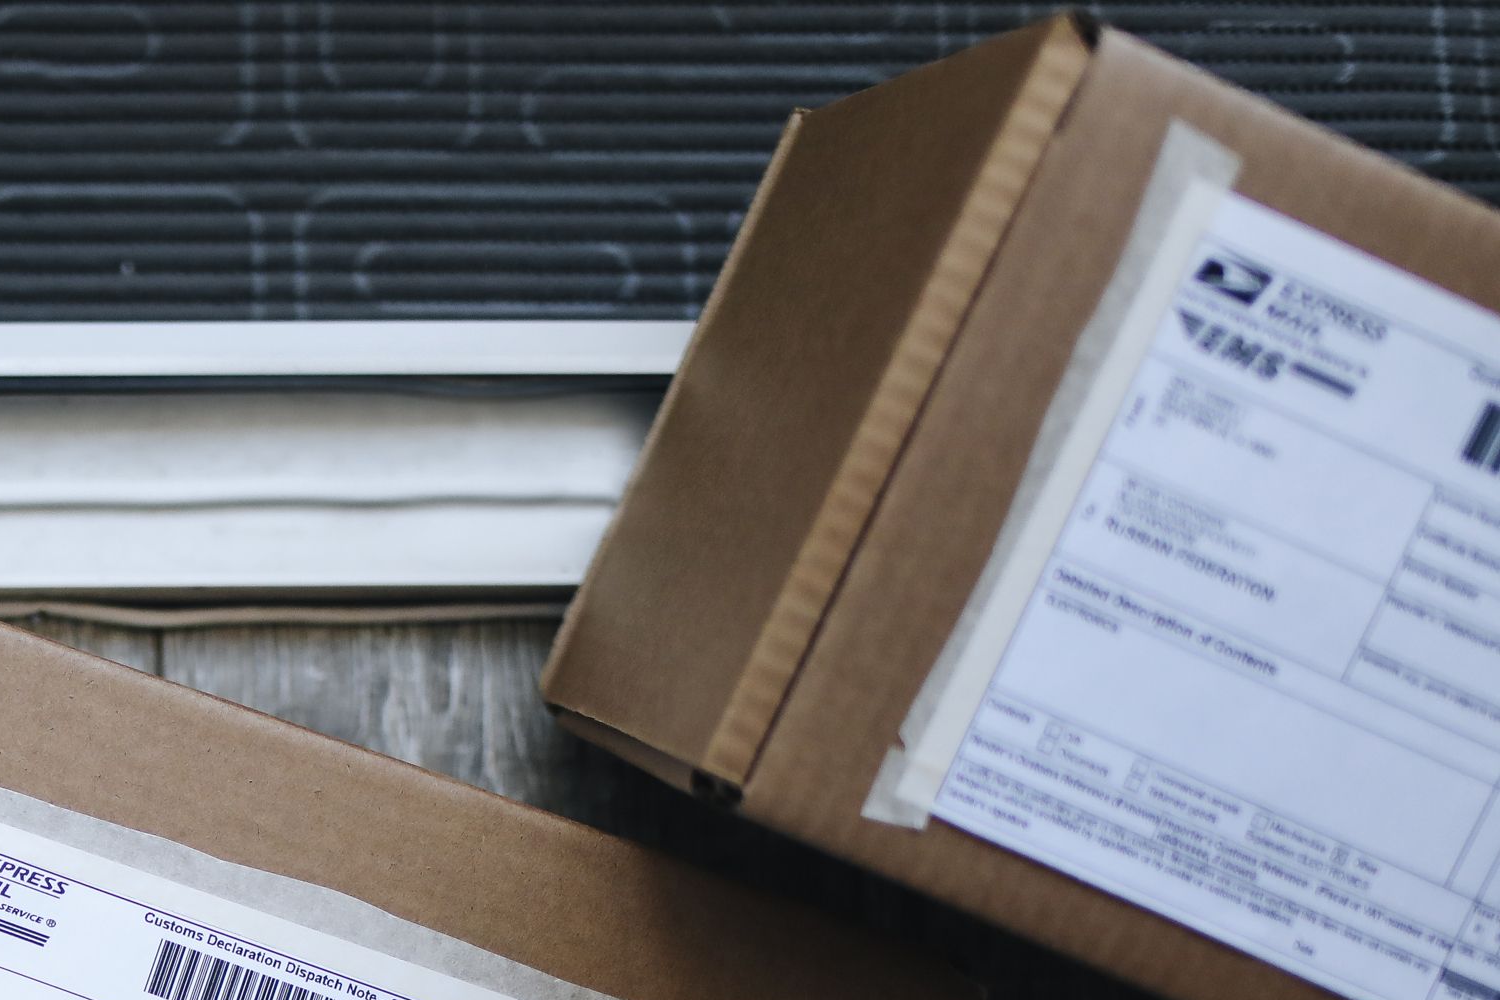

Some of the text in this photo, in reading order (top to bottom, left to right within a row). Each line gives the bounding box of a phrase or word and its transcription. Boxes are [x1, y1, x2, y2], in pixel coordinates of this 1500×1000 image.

[144, 911, 204, 941] Customs
[206, 933, 282, 969] Declaration
[284, 960, 343, 991] Dispatch
